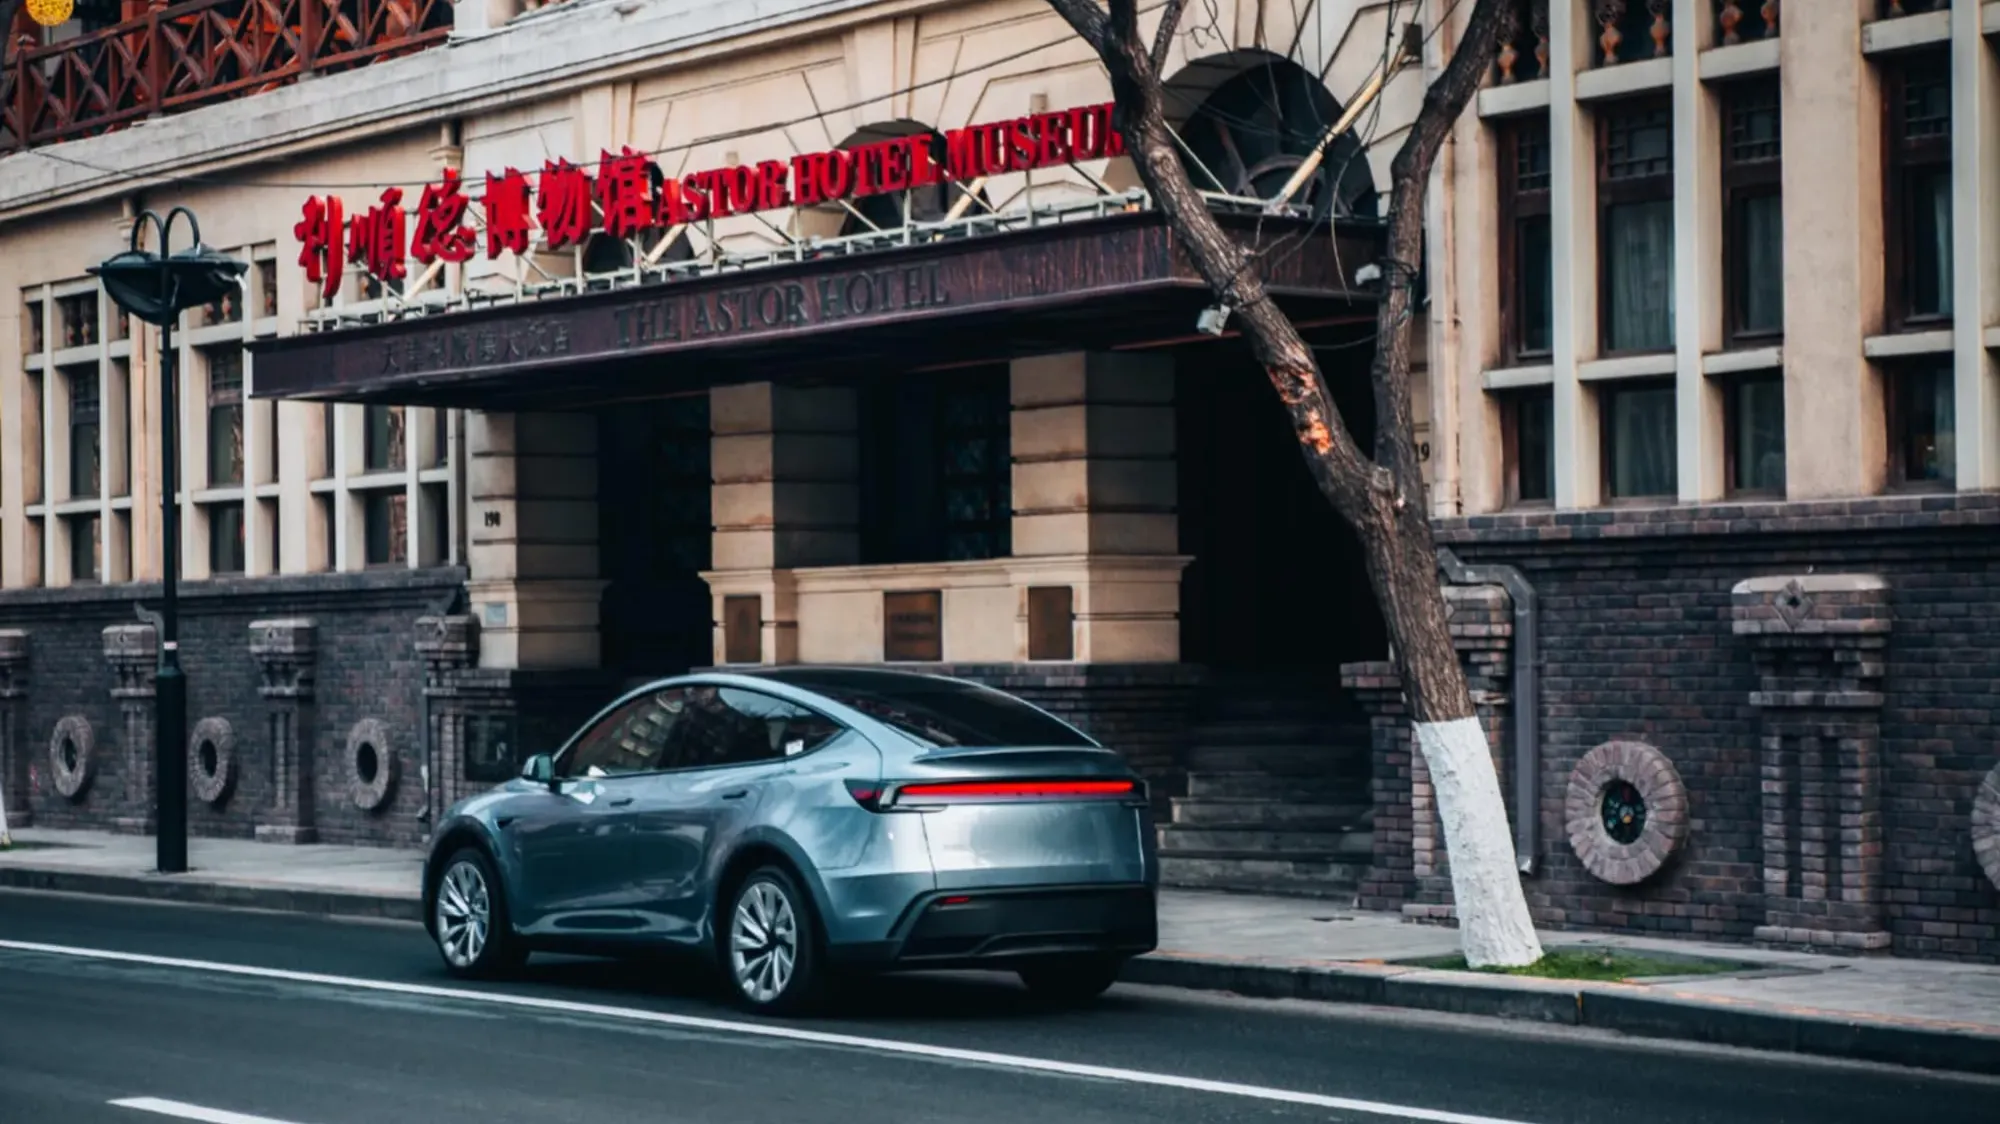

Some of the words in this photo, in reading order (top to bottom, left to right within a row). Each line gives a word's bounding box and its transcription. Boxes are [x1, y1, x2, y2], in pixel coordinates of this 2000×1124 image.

[656, 159, 791, 227] ASTOR
[791, 134, 943, 206] HOTEL
[614, 298, 682, 348] THE
[688, 282, 810, 338] ASTOR
[817, 261, 950, 322] HOTEL
